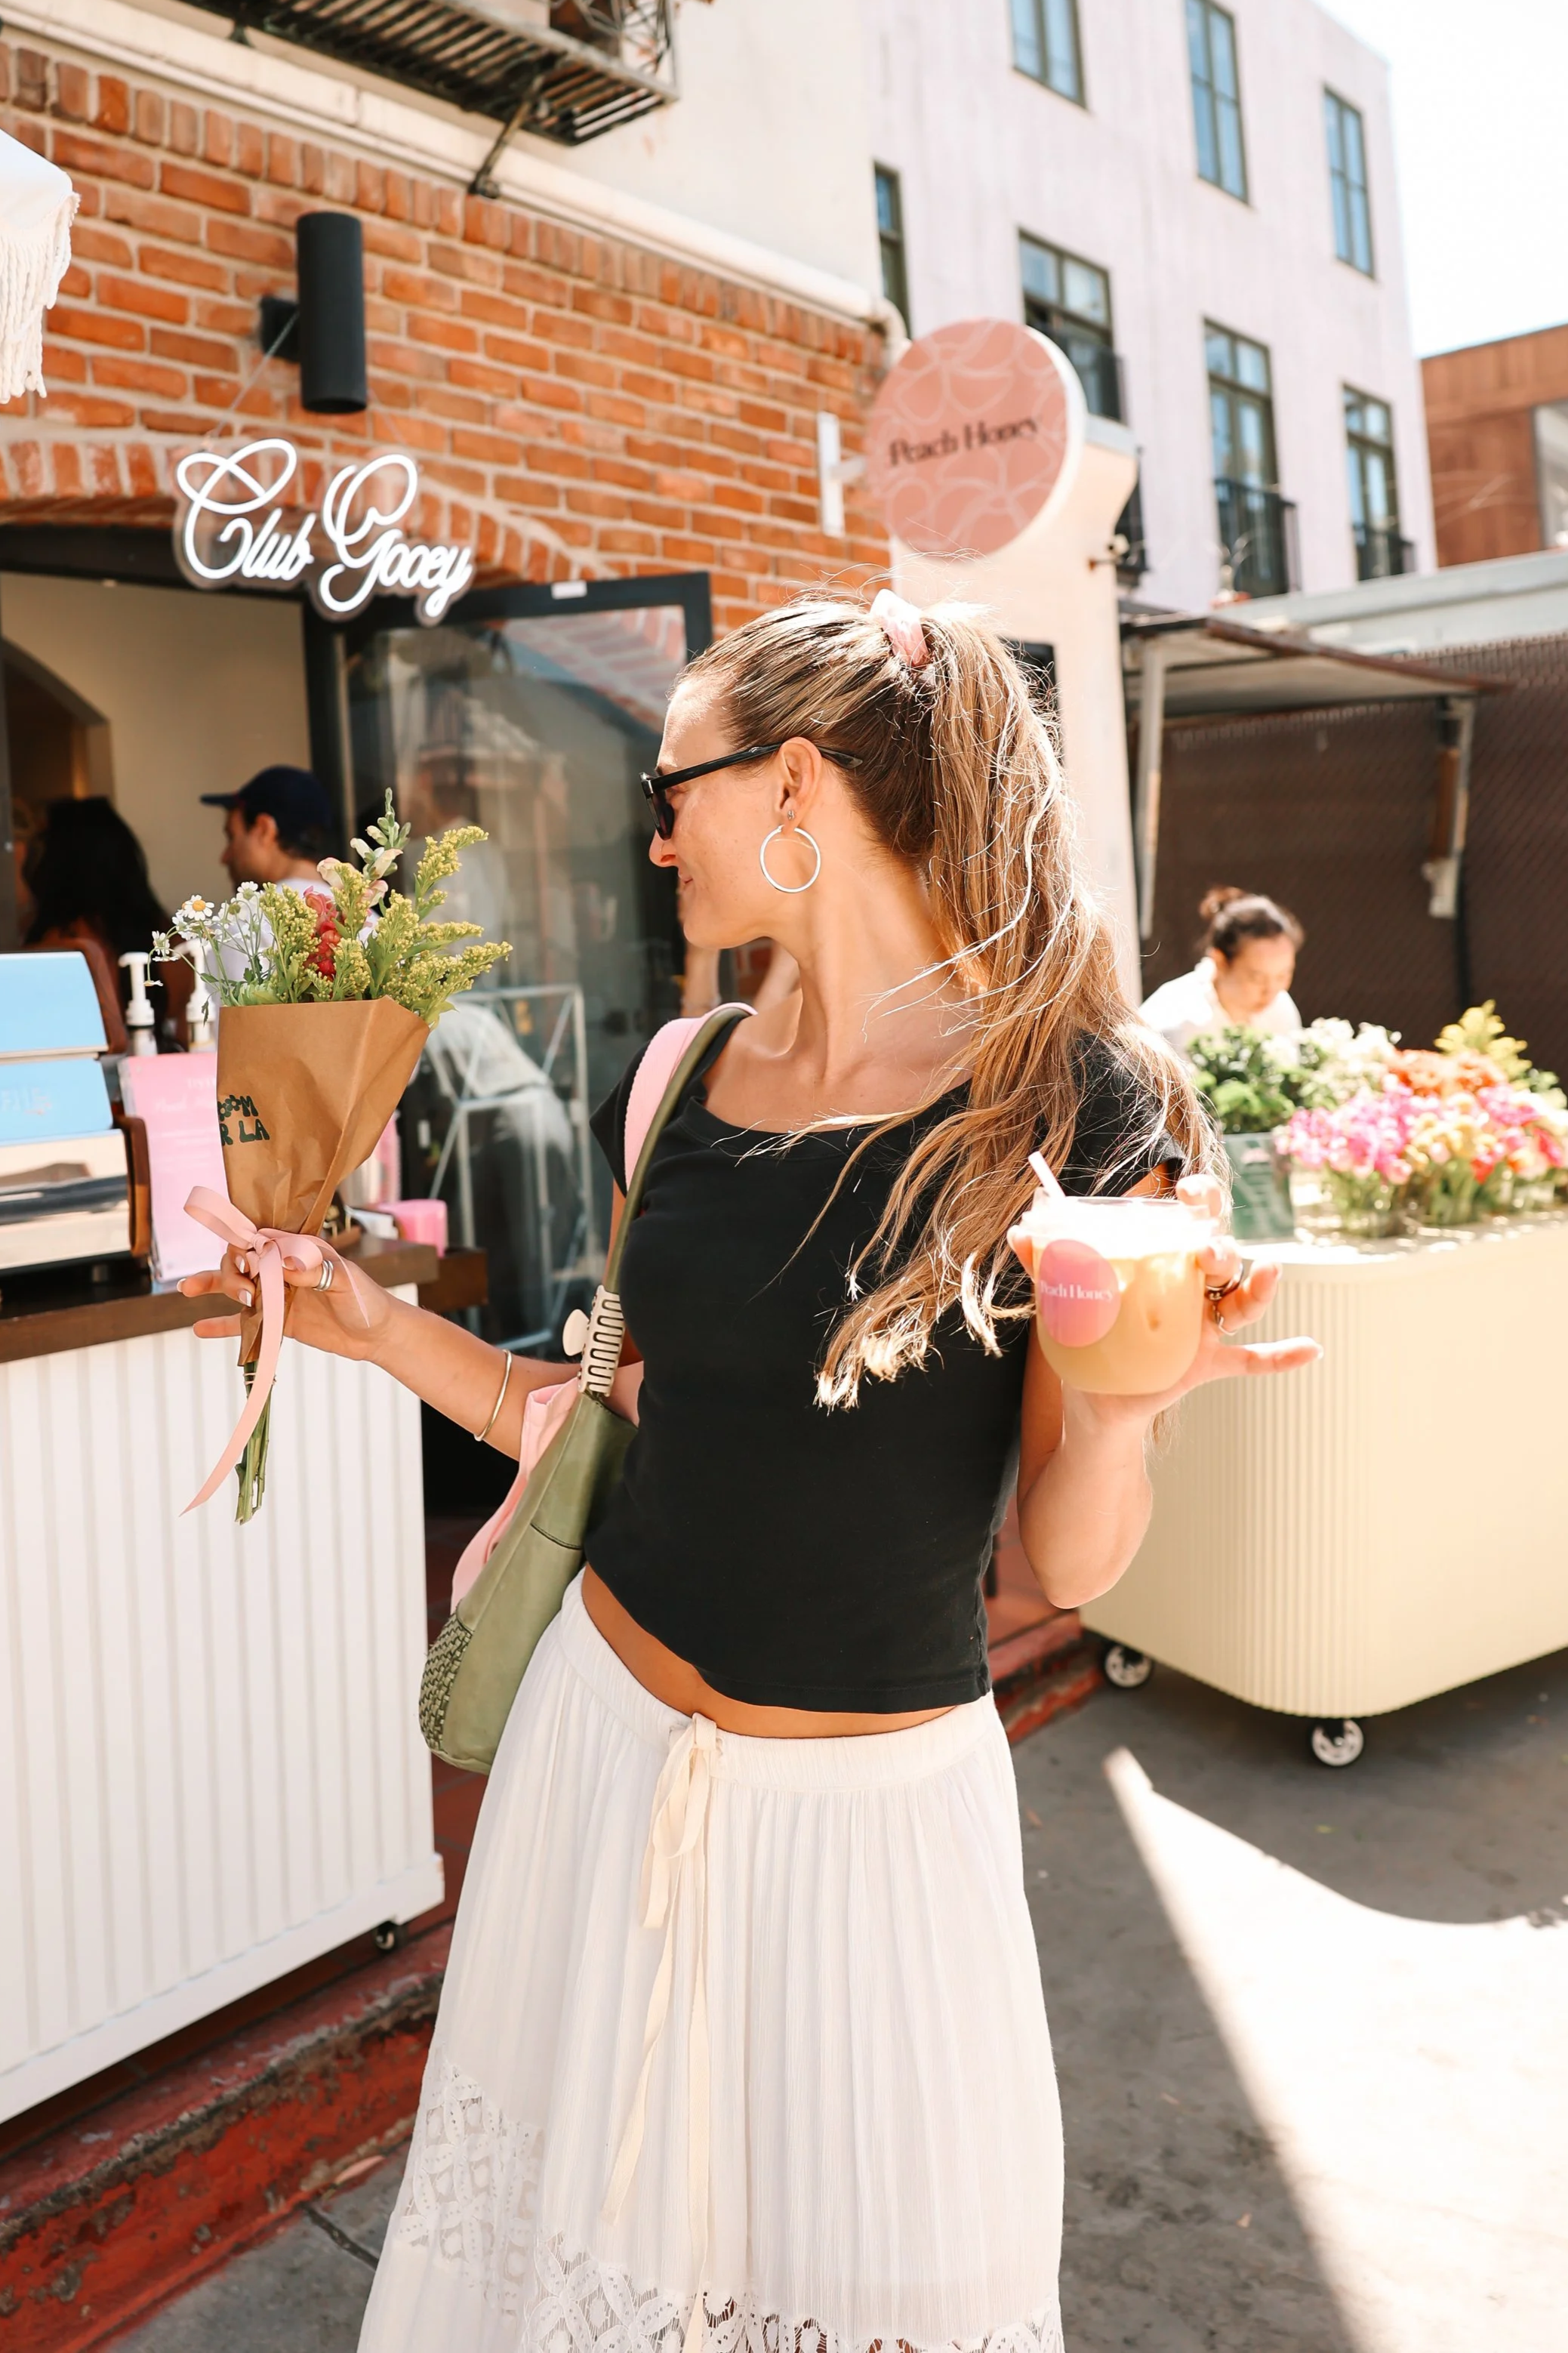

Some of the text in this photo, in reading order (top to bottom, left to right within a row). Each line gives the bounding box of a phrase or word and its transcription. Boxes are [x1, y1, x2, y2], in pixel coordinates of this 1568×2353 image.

[889, 418, 1038, 467] Peach Honey
[177, 438, 476, 618] Club Gooey
[239, 1118, 270, 1143] LA
[1069, 1284, 1114, 1303] Honey
